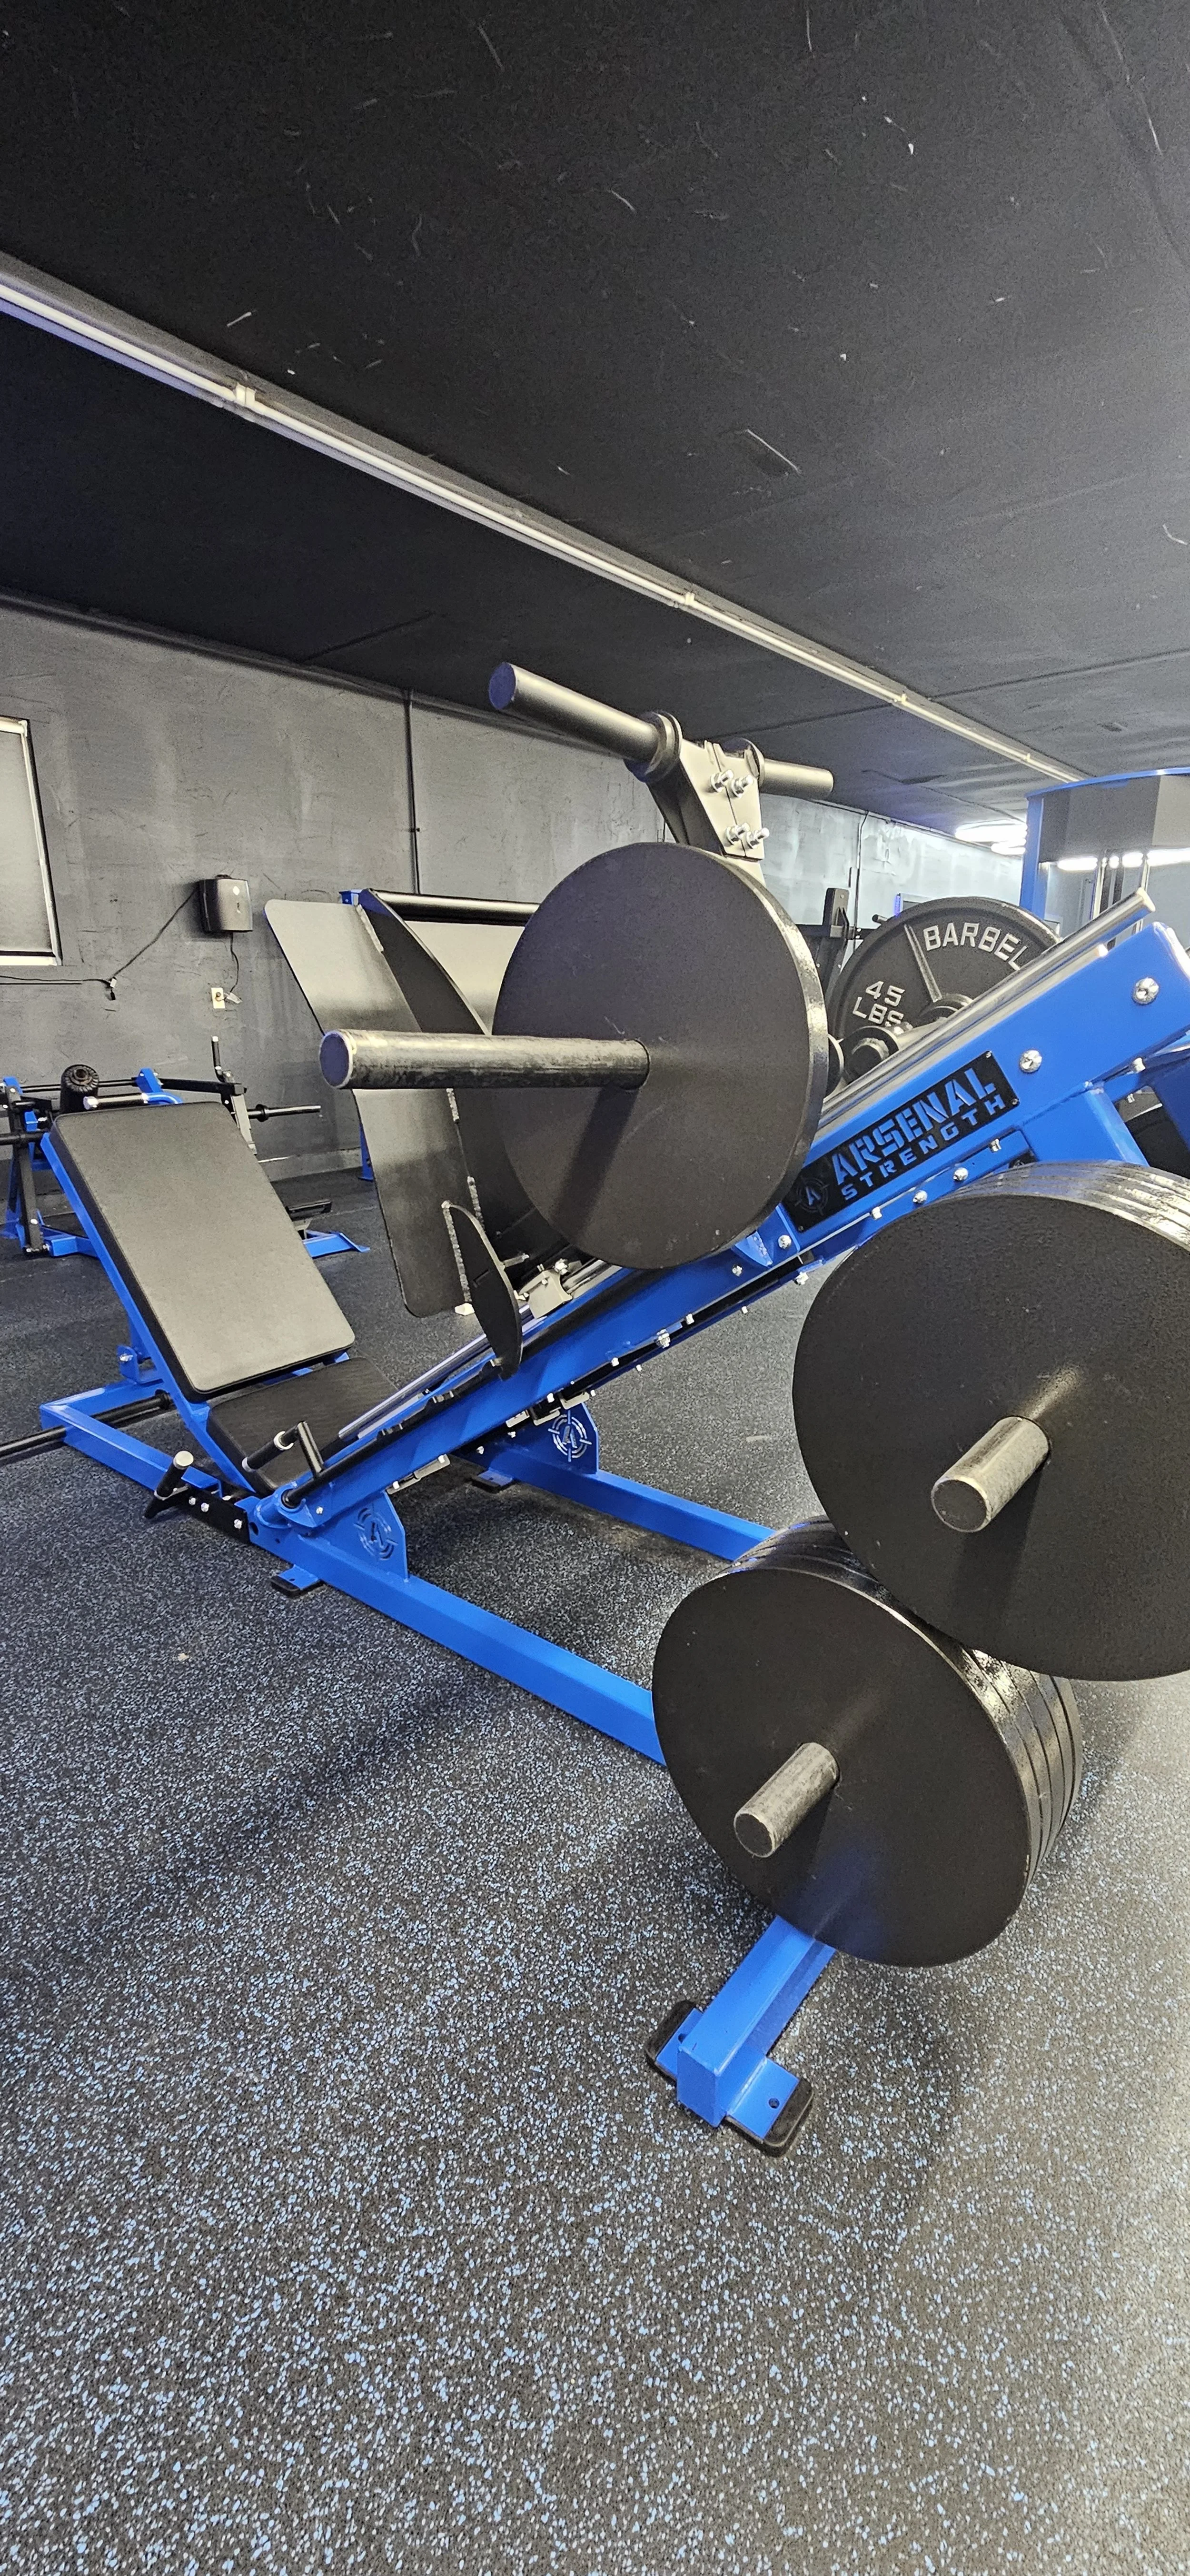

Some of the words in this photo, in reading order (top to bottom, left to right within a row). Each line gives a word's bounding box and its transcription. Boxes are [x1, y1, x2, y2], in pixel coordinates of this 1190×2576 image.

[922, 922, 1028, 971] BARBEL
[852, 996, 904, 1027] LBS
[865, 981, 905, 1007] 45
[831, 1067, 997, 1185] ARSENAL
[841, 1094, 1006, 1201] STRENGTH
